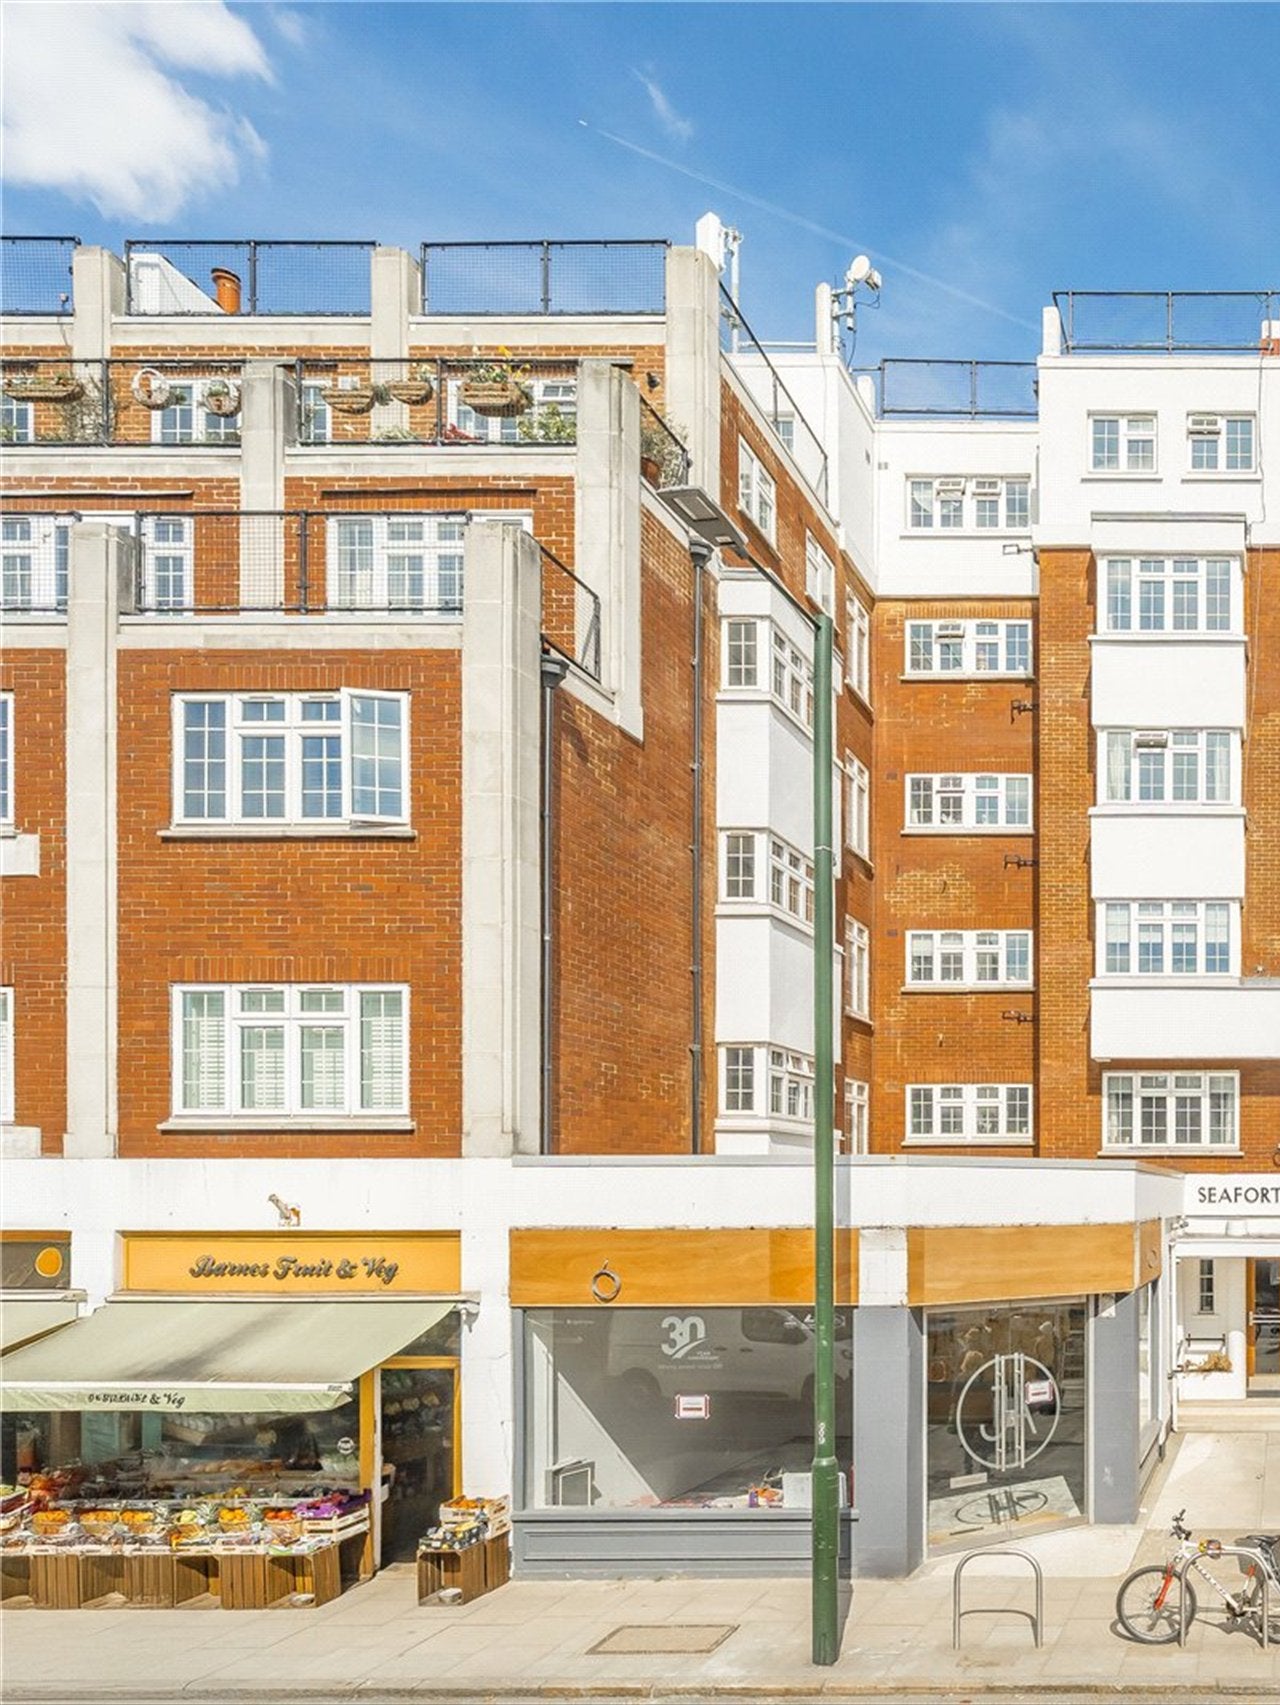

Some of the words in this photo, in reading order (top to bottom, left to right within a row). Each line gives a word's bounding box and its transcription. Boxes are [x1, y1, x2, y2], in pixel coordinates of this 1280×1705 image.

[188, 1254, 270, 1278] Barnes
[272, 1256, 334, 1281] Fruit
[335, 1257, 359, 1280] &
[360, 1256, 400, 1285] Veg
[660, 1315, 707, 1357] 30
